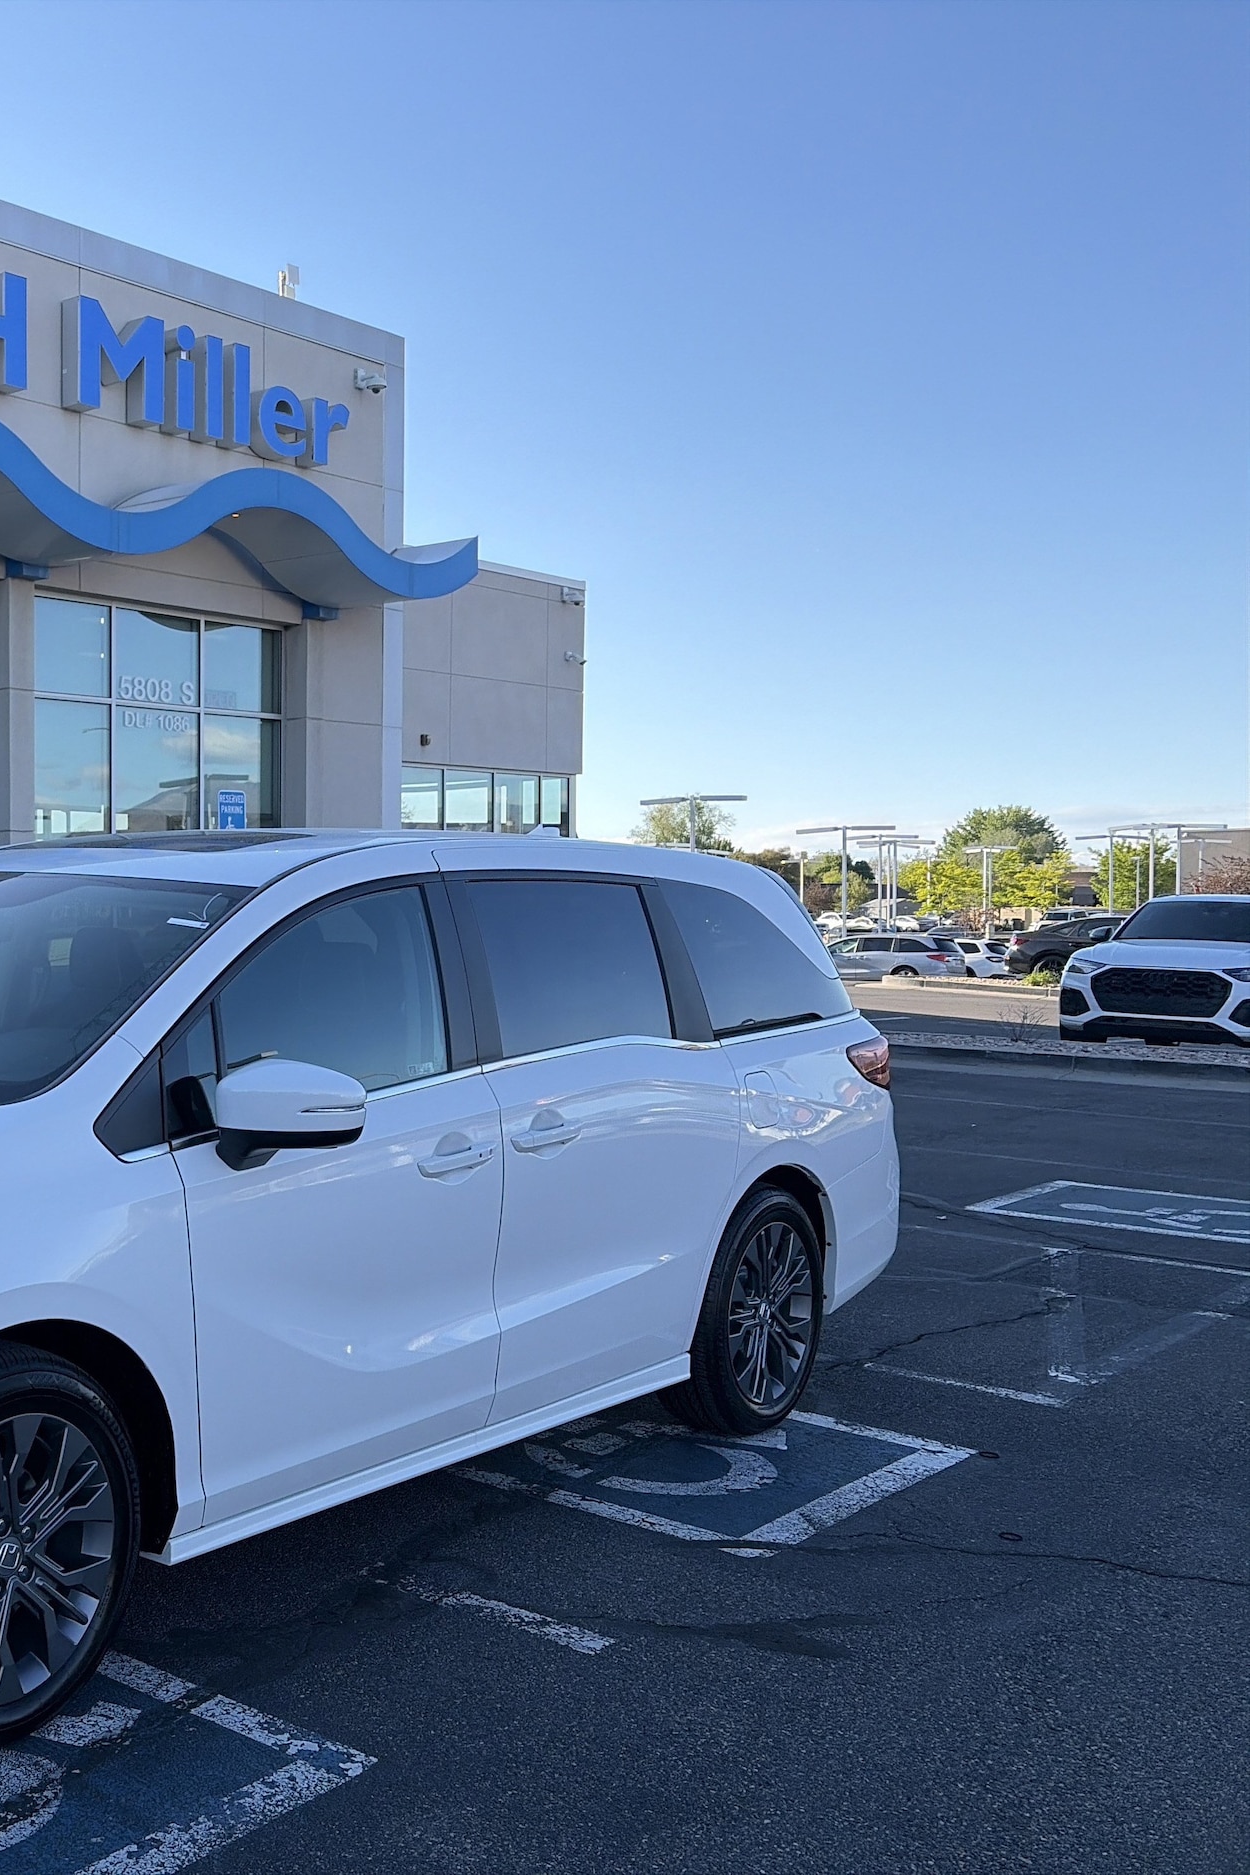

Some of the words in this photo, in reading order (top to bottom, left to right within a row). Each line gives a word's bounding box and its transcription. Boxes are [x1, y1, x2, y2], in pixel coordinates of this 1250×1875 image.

[61, 295, 349, 468] Miller
[119, 676, 172, 702] 5808
[180, 681, 194, 705] S
[157, 715, 190, 732] 1086
[220, 794, 244, 803] RESERVED
[221, 805, 243, 814] PARKING
